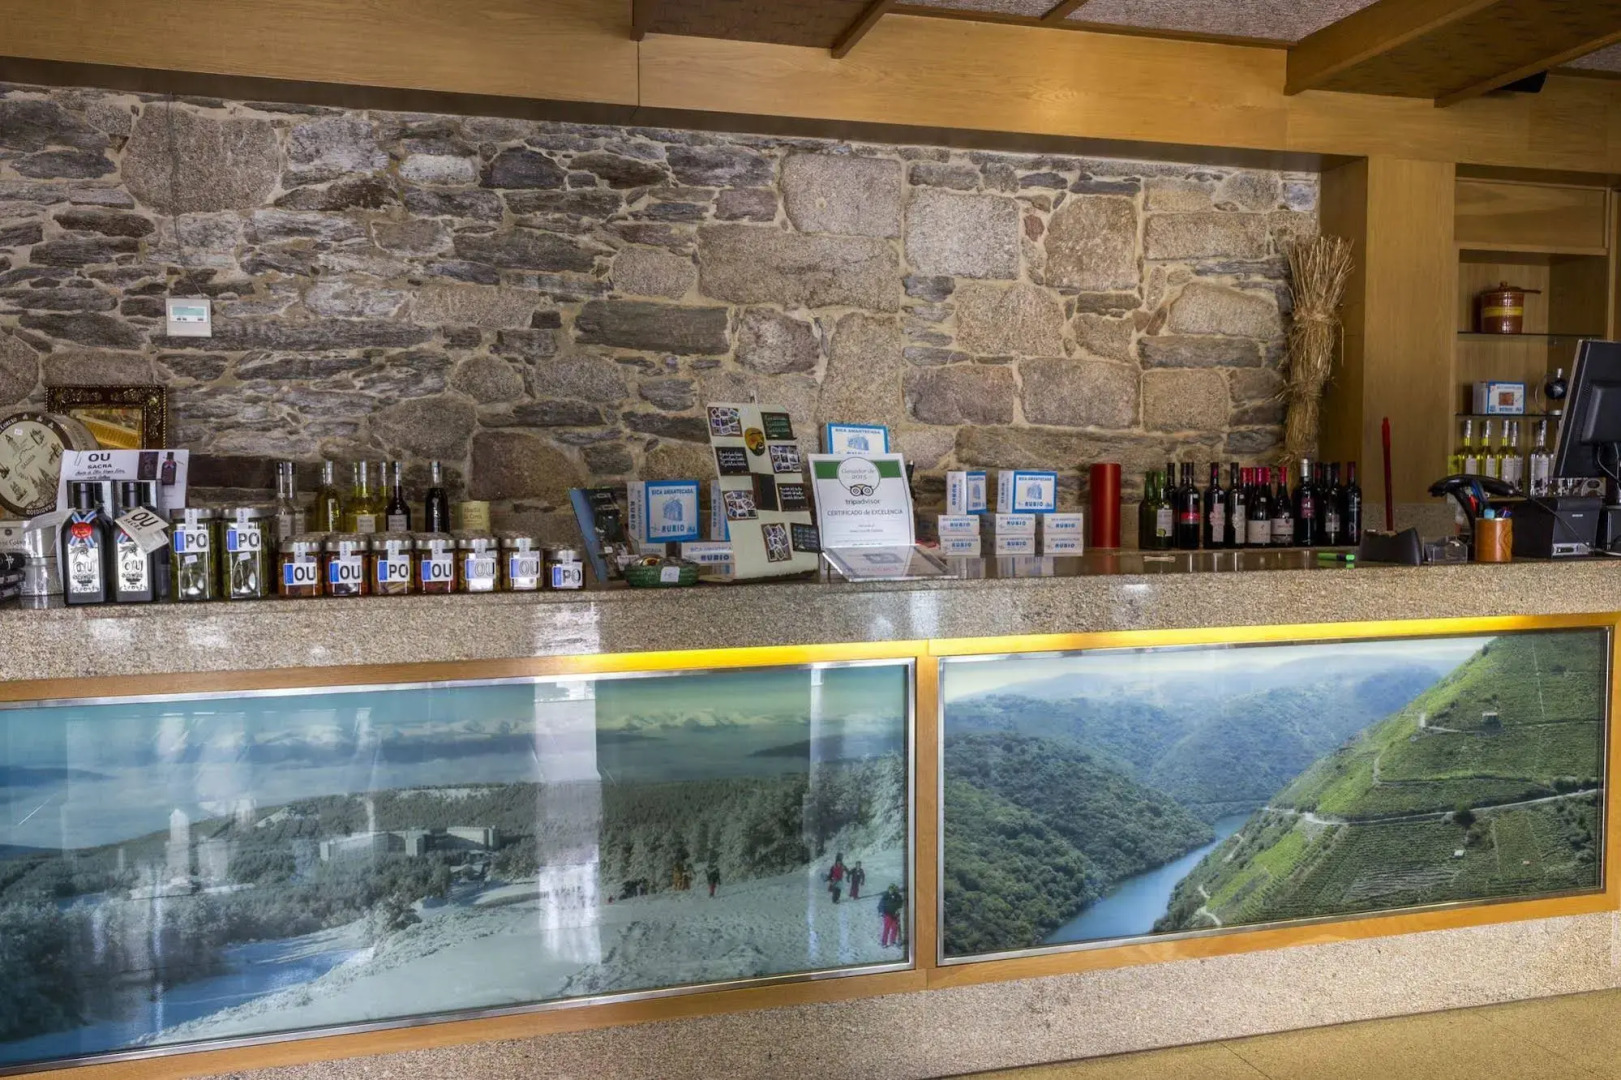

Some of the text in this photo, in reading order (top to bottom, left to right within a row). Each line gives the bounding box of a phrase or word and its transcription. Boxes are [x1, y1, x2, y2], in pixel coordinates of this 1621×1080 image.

[88, 453, 111, 462] OU
[131, 511, 159, 528] OU
[661, 525, 685, 533] RUBIO
[185, 533, 208, 549] PO
[238, 532, 260, 548] PO
[75, 561, 93, 573] OU
[124, 560, 143, 572] OU
[294, 566, 316, 581] OU
[340, 565, 361, 580] OU
[388, 564, 408, 578] PO
[432, 563, 452, 578] OU
[474, 562, 494, 577] OU
[519, 560, 539, 576] OU
[562, 568, 581, 583] PO
